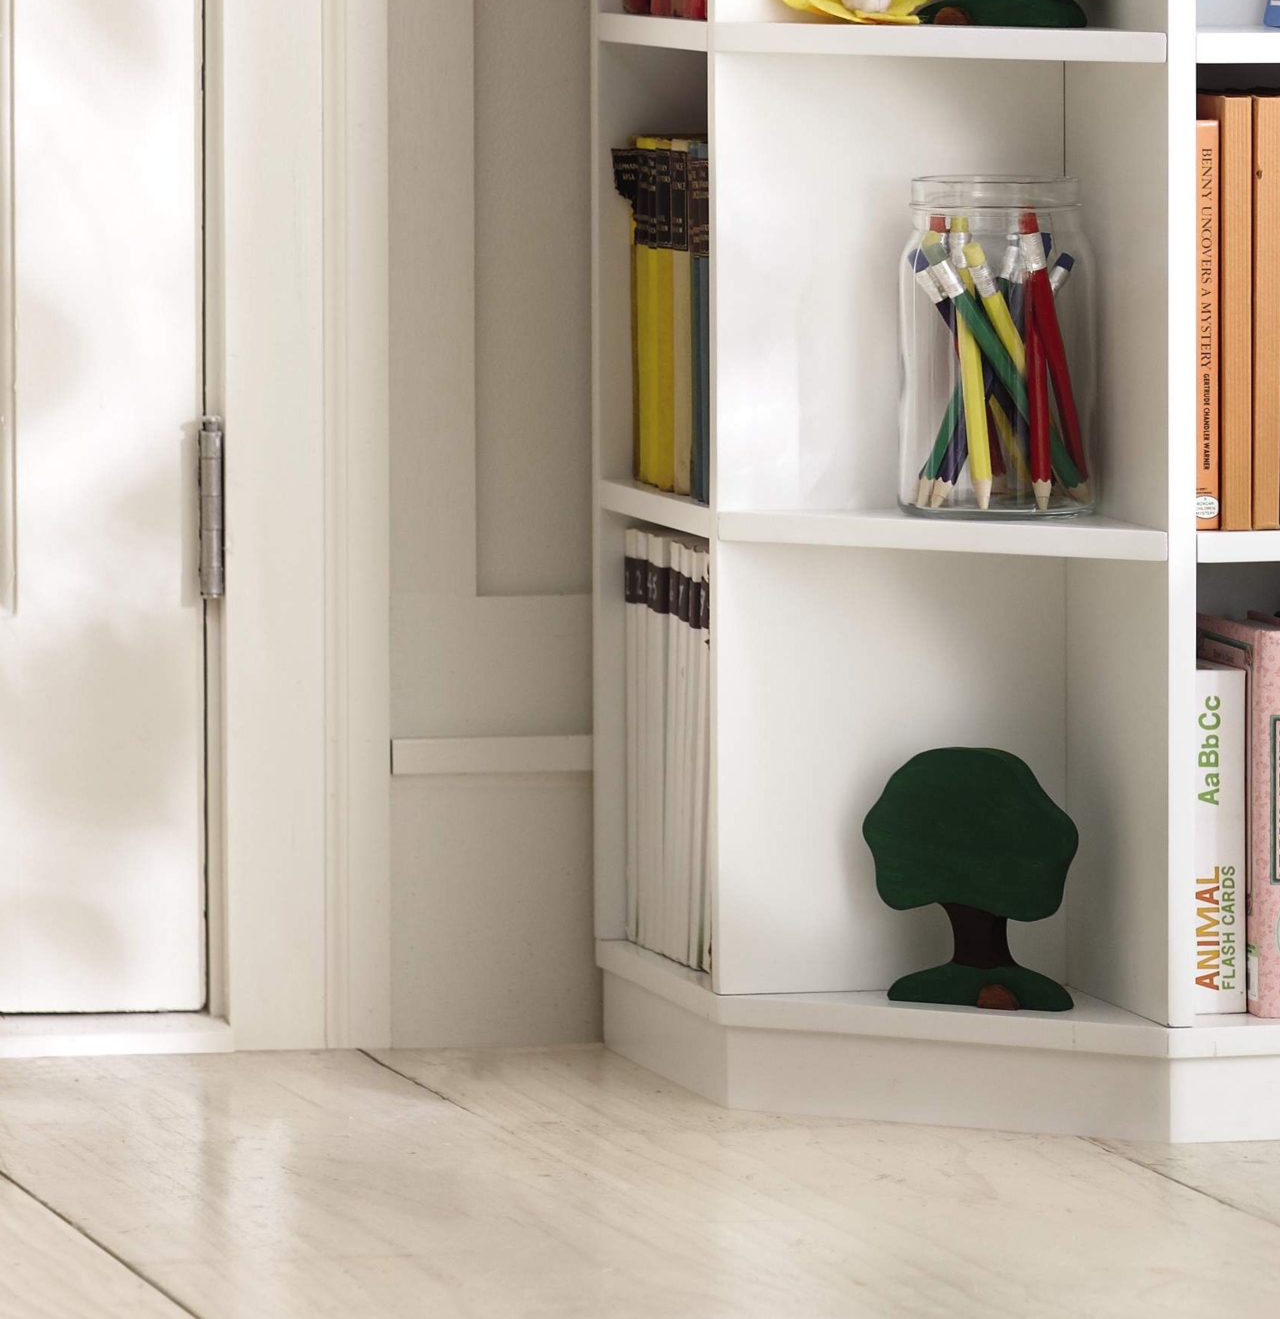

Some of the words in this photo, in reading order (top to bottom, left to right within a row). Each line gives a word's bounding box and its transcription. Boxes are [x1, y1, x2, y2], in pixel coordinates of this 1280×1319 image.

[1201, 148, 1212, 200] BENNY
[1201, 206, 1212, 284] UNCOVERS
[1201, 288, 1211, 297] A
[1200, 302, 1212, 370] MYSTERY
[1202, 443, 1210, 470] WARNER
[1198, 696, 1222, 730] Cc
[1198, 734, 1219, 768] Bb
[1198, 772, 1221, 806] Aa
[1222, 866, 1236, 926] CARDS
[1195, 866, 1220, 991] ANIMAL
[1222, 932, 1236, 990] FLASH
